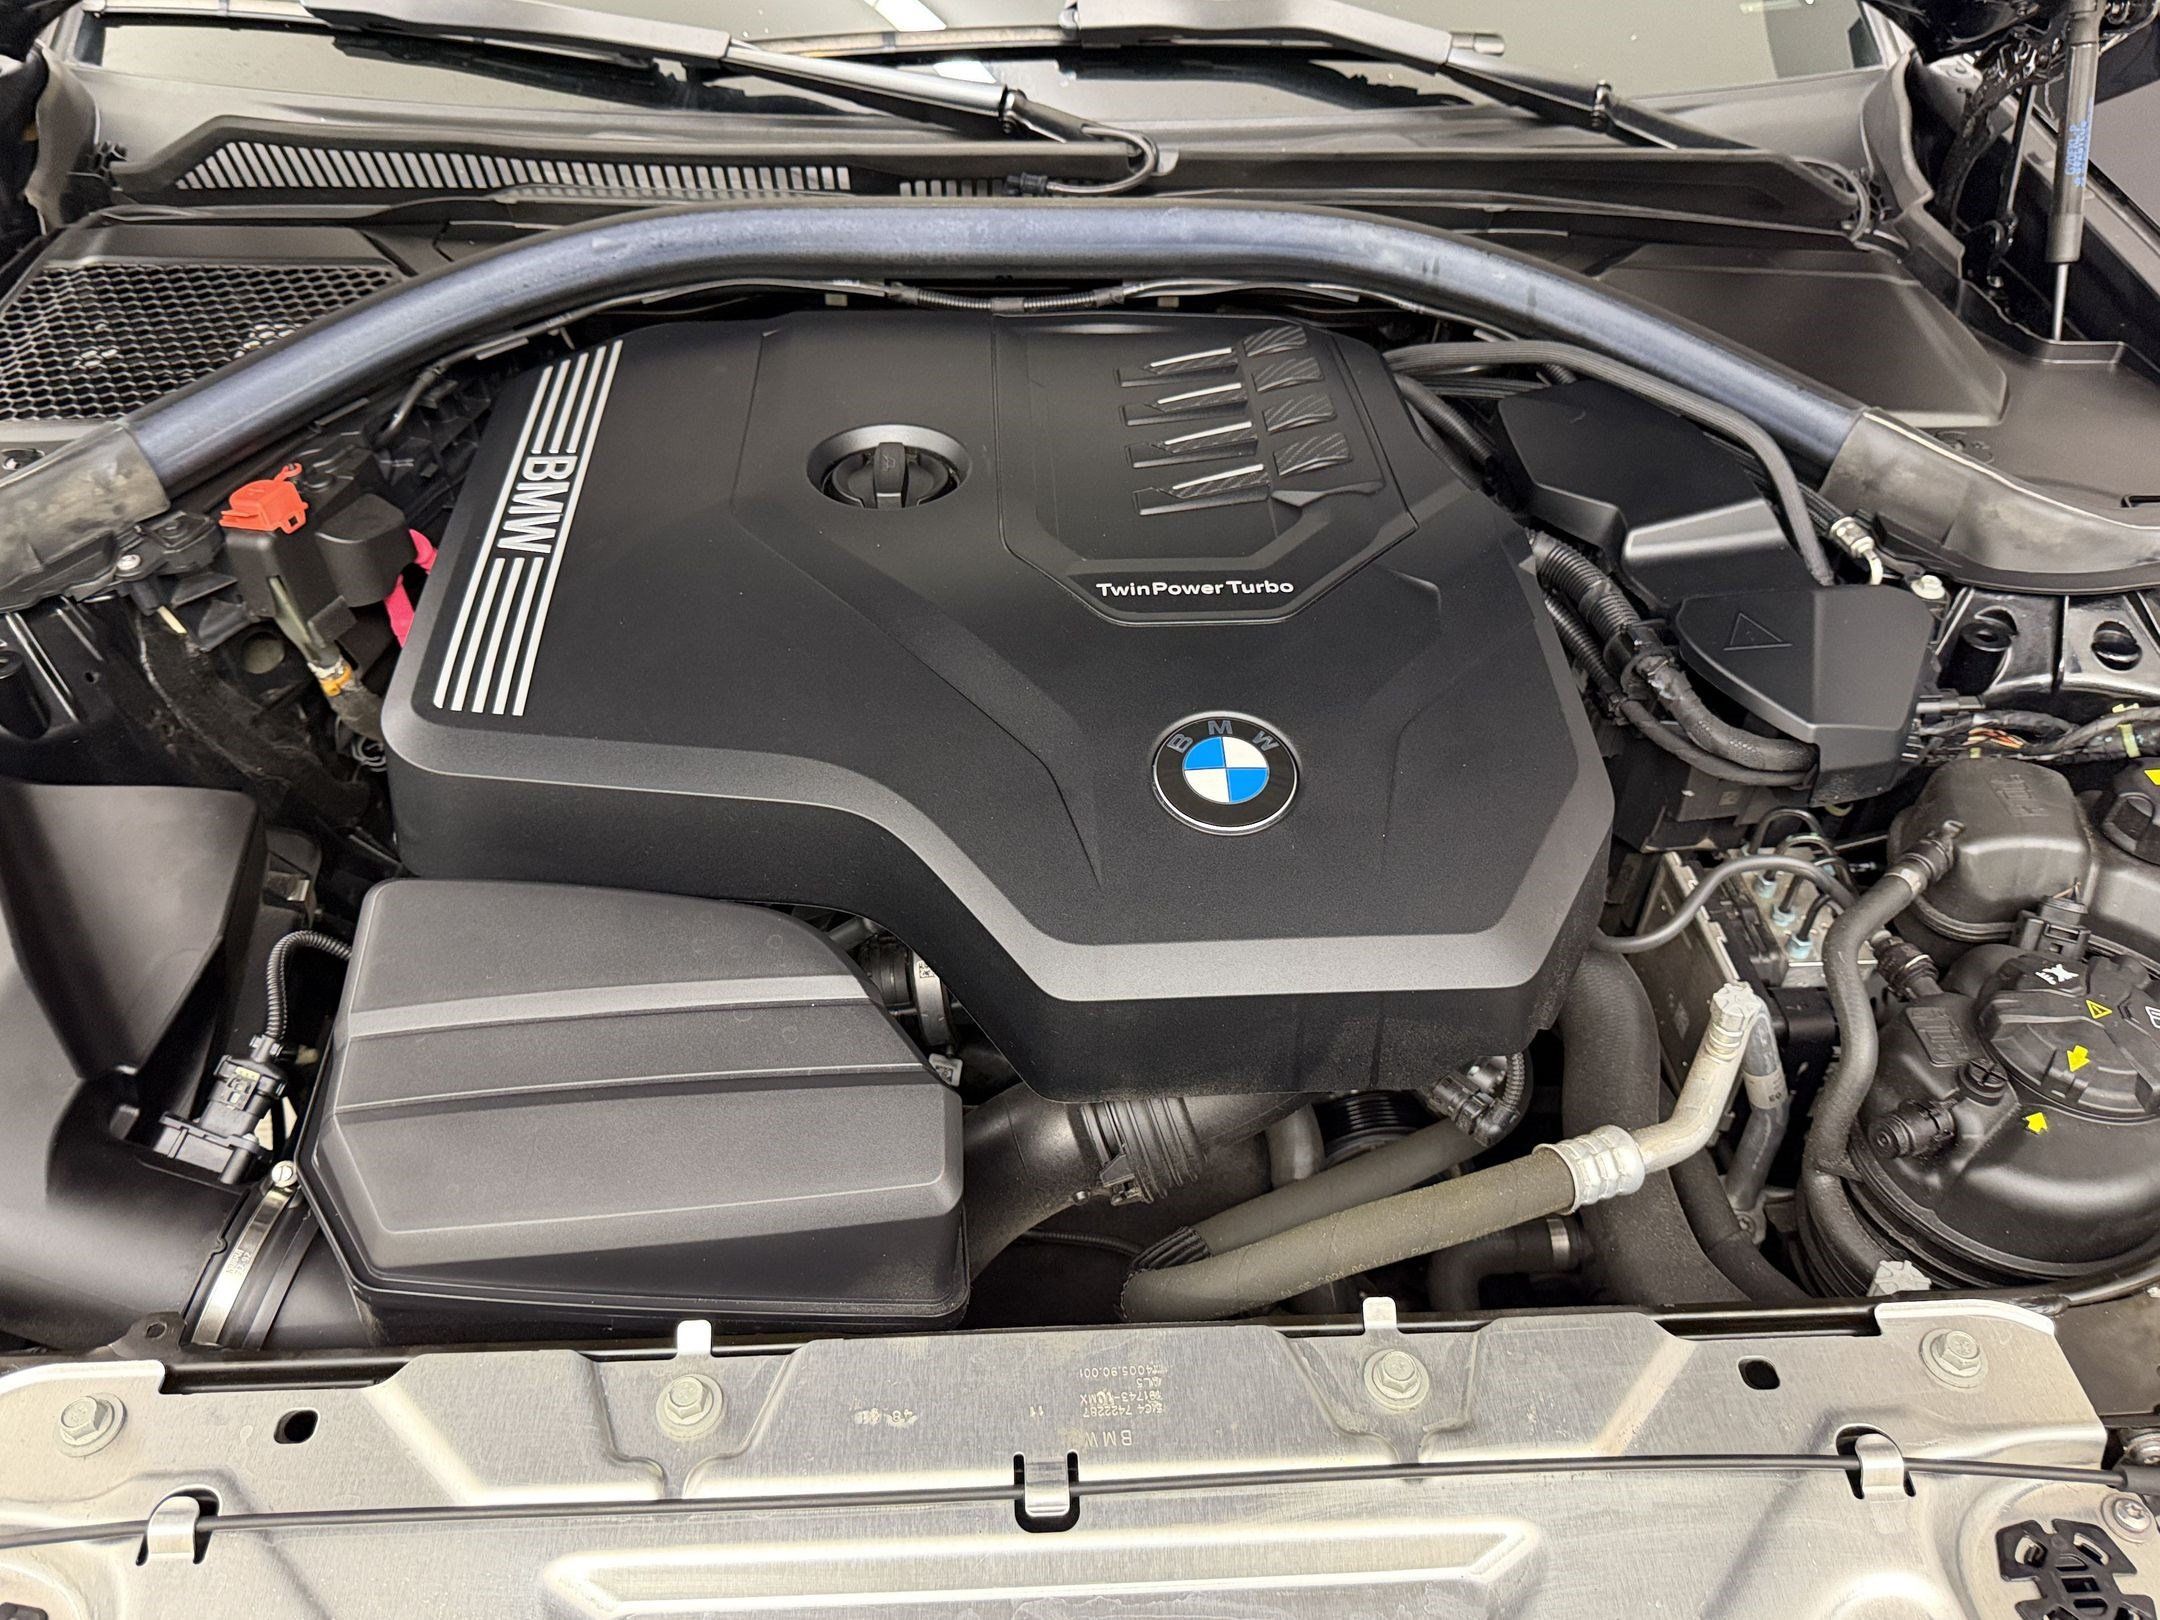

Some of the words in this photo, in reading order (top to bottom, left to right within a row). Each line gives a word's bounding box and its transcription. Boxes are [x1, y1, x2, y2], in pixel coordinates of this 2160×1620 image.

[497, 456, 578, 554] BMW
[1226, 579, 1295, 595] Turbo
[1167, 719, 1279, 753] BMW
[1084, 1429, 1133, 1447] BMW
